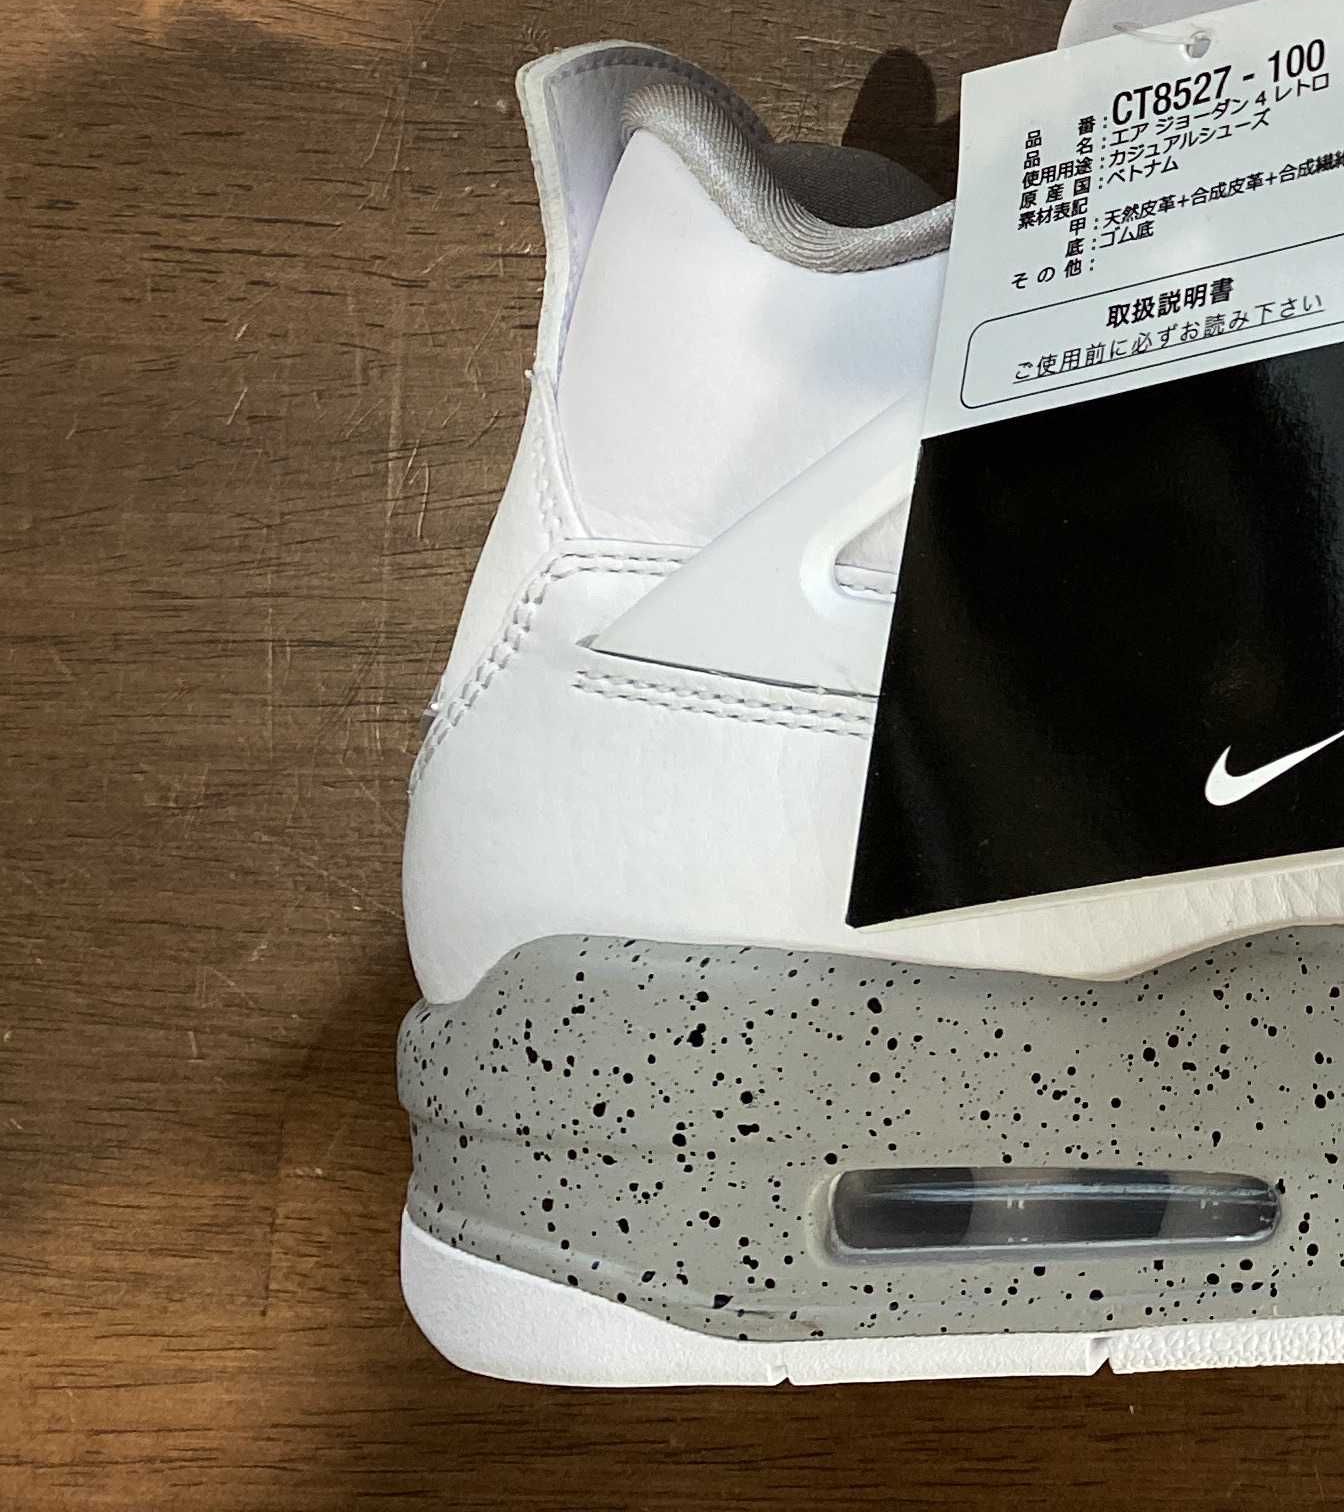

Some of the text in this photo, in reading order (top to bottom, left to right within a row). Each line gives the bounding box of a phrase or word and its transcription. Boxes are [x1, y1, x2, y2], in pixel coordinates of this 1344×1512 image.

[1112, 65, 1232, 125] CT8527
[1268, 39, 1325, 82] 100
[1108, 108, 1271, 168] カジュアルシューズ
[1107, 156, 1179, 184] ベトナム
[1017, 197, 1088, 230] 素材表記
[1099, 220, 1155, 248] ゴム底
[1105, 277, 1234, 329] 取扱説明書
[1014, 294, 1324, 380] ご使用前に必ずお読み下さい
